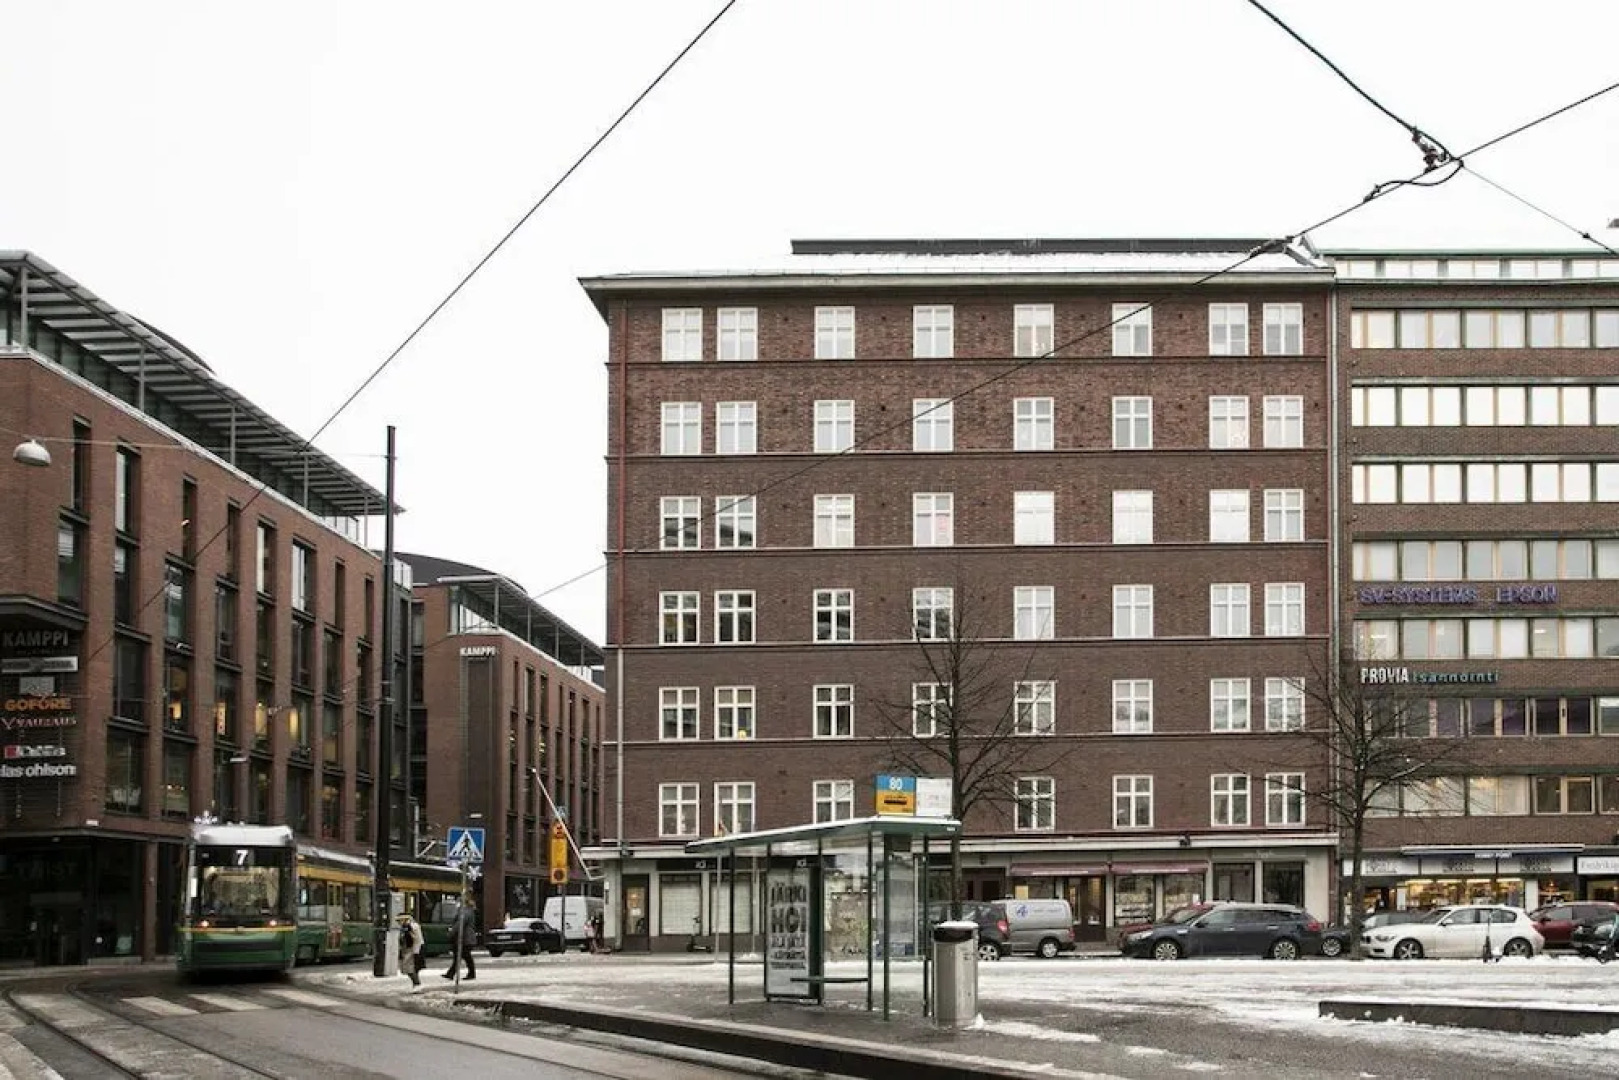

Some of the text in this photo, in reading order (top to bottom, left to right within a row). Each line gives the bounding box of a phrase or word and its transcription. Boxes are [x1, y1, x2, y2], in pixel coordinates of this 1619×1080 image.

[1496, 585, 1557, 604] EPSON
[3, 630, 69, 647] KAMPPI
[460, 646, 496, 657] KAMPPI
[1360, 667, 1410, 684] PROVIA
[5, 697, 72, 711] GOFORE
[25, 763, 77, 777] ohlson
[889, 776, 903, 791] 80
[235, 849, 249, 866] 7
